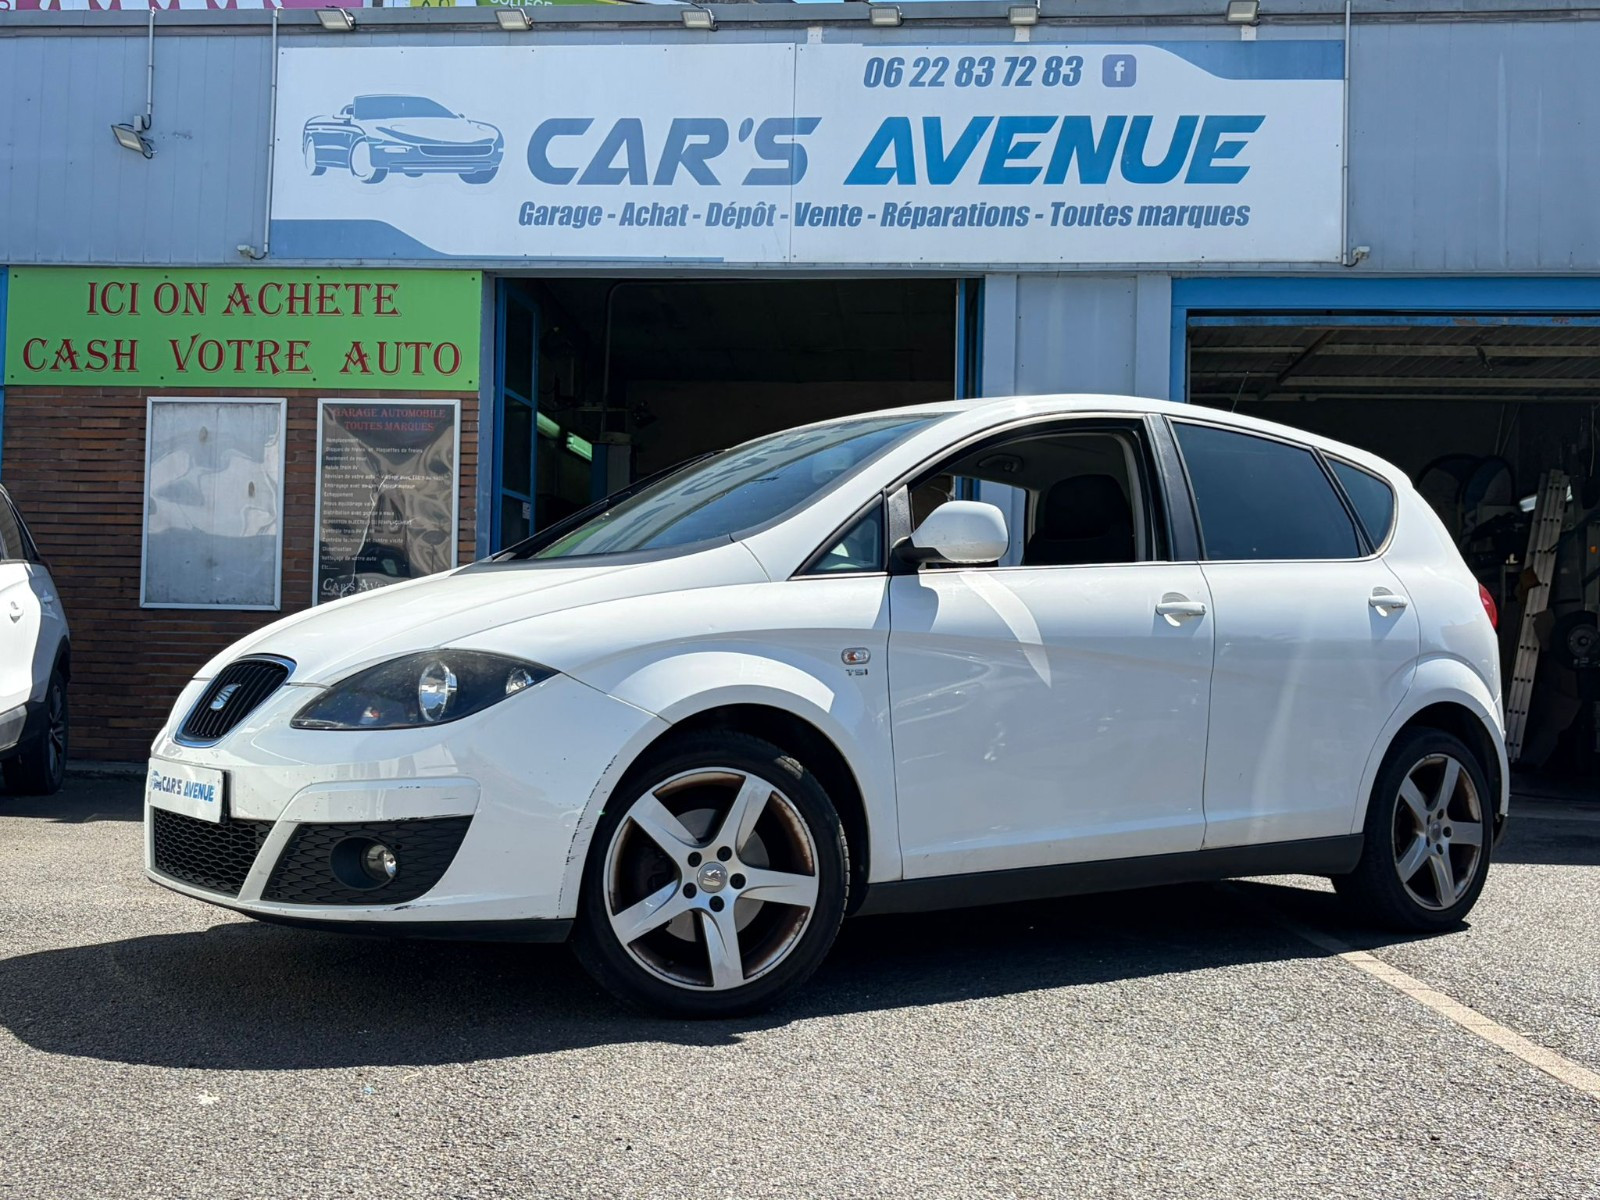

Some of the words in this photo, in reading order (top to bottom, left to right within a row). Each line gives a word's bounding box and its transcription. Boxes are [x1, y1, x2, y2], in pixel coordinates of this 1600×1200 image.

[863, 56, 905, 88] 06
[909, 56, 951, 88] 22
[954, 56, 995, 88] 83
[1002, 56, 1033, 87] 72
[1041, 56, 1084, 87] 83
[527, 117, 822, 186] CAR'S
[843, 115, 1267, 186] AVENUE
[518, 201, 603, 229] Garage
[618, 202, 689, 227] Achat
[705, 202, 776, 229] Dépôt
[794, 202, 863, 227] Vente
[880, 201, 1030, 230] Réparations
[1049, 202, 1143, 227] Toutes
[1137, 204, 1250, 229] marques
[86, 282, 140, 316] ICI
[153, 282, 210, 316] ON
[222, 282, 402, 317] ACHETE
[22, 337, 139, 372] CASH
[169, 333, 313, 376] VOTRE
[339, 340, 463, 376] AUTO
[333, 408, 378, 418] GARAGE
[380, 408, 446, 418] AUTOMOBILE
[343, 421, 382, 431] TOUTES
[384, 421, 435, 432] MARQUES
[184, 780, 215, 802] AVENUE
